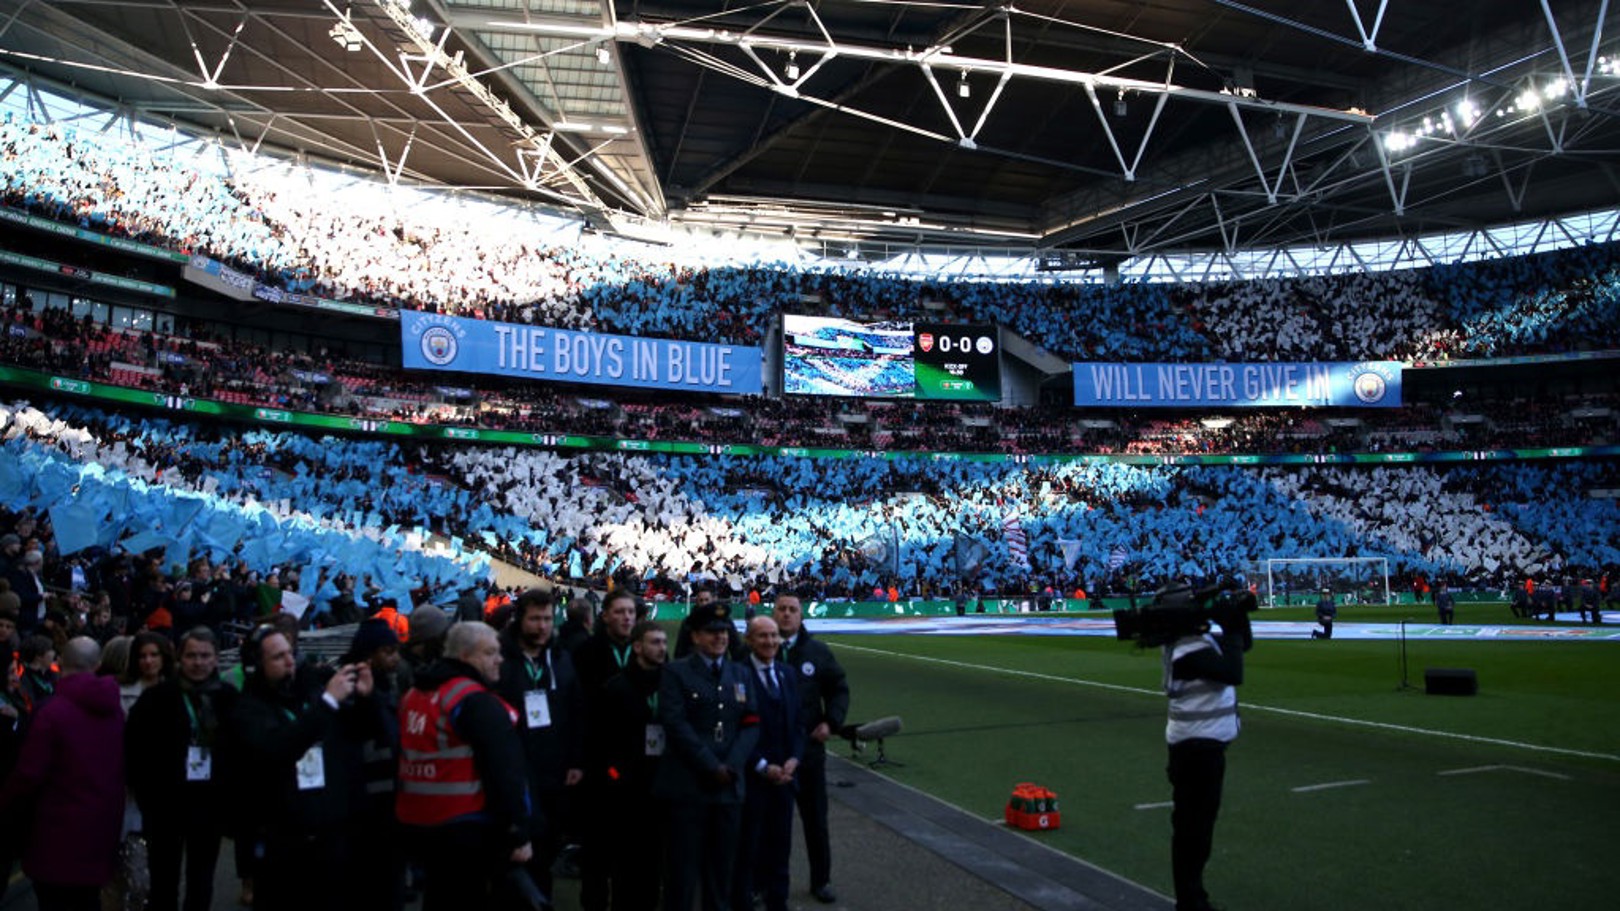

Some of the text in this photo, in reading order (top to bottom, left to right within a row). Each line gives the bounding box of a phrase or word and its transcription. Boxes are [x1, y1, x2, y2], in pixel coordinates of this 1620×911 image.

[494, 325, 732, 386] THE BOYS IN BLUE
[1090, 365, 1331, 401] WILL NEVER GIVE IN
